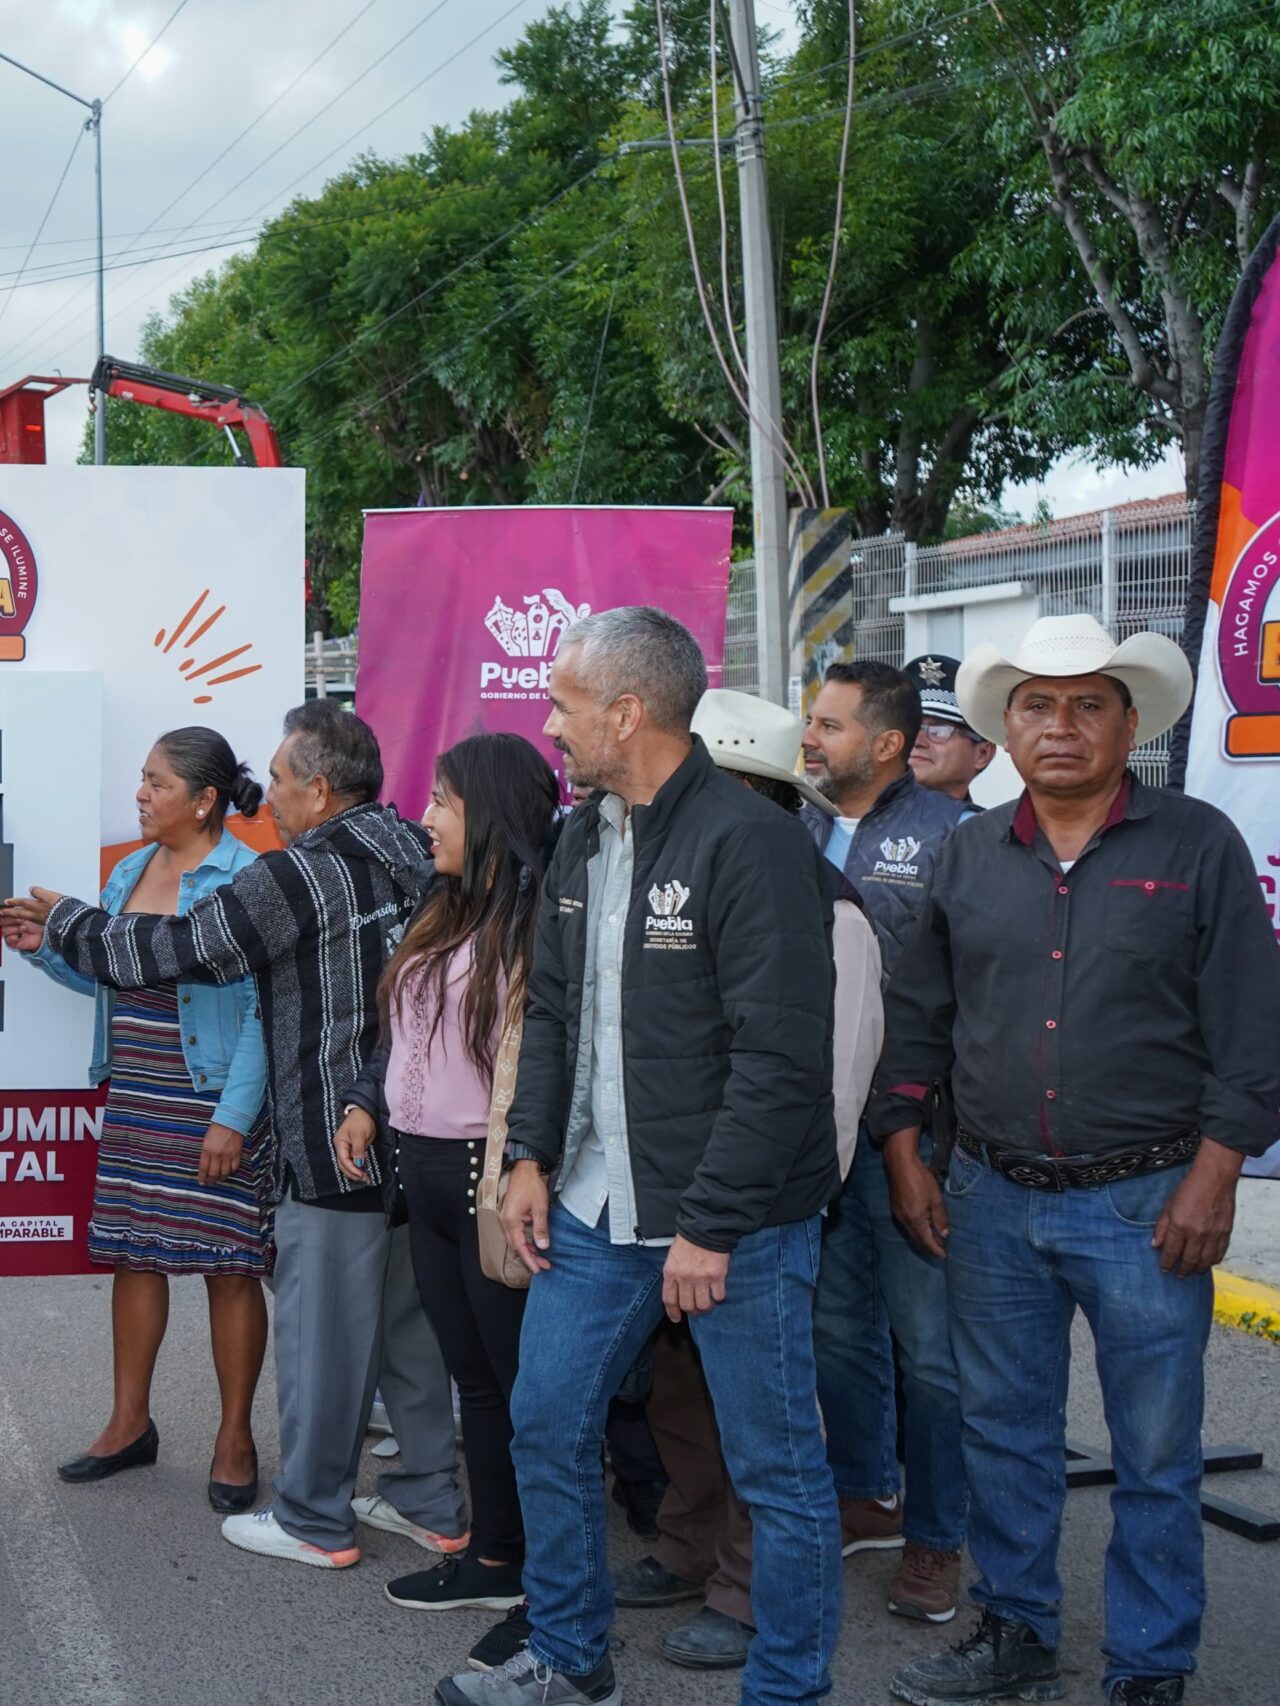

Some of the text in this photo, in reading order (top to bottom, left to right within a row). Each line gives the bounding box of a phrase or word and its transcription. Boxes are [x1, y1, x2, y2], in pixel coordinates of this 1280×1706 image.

[0, 528, 13, 543] SE
[11, 545, 28, 599] ILUMINE
[1234, 551, 1278, 656] HAGAMOS
[480, 661, 554, 689] Pueb
[873, 860, 919, 875] Puebla
[645, 915, 693, 931] Puebla
